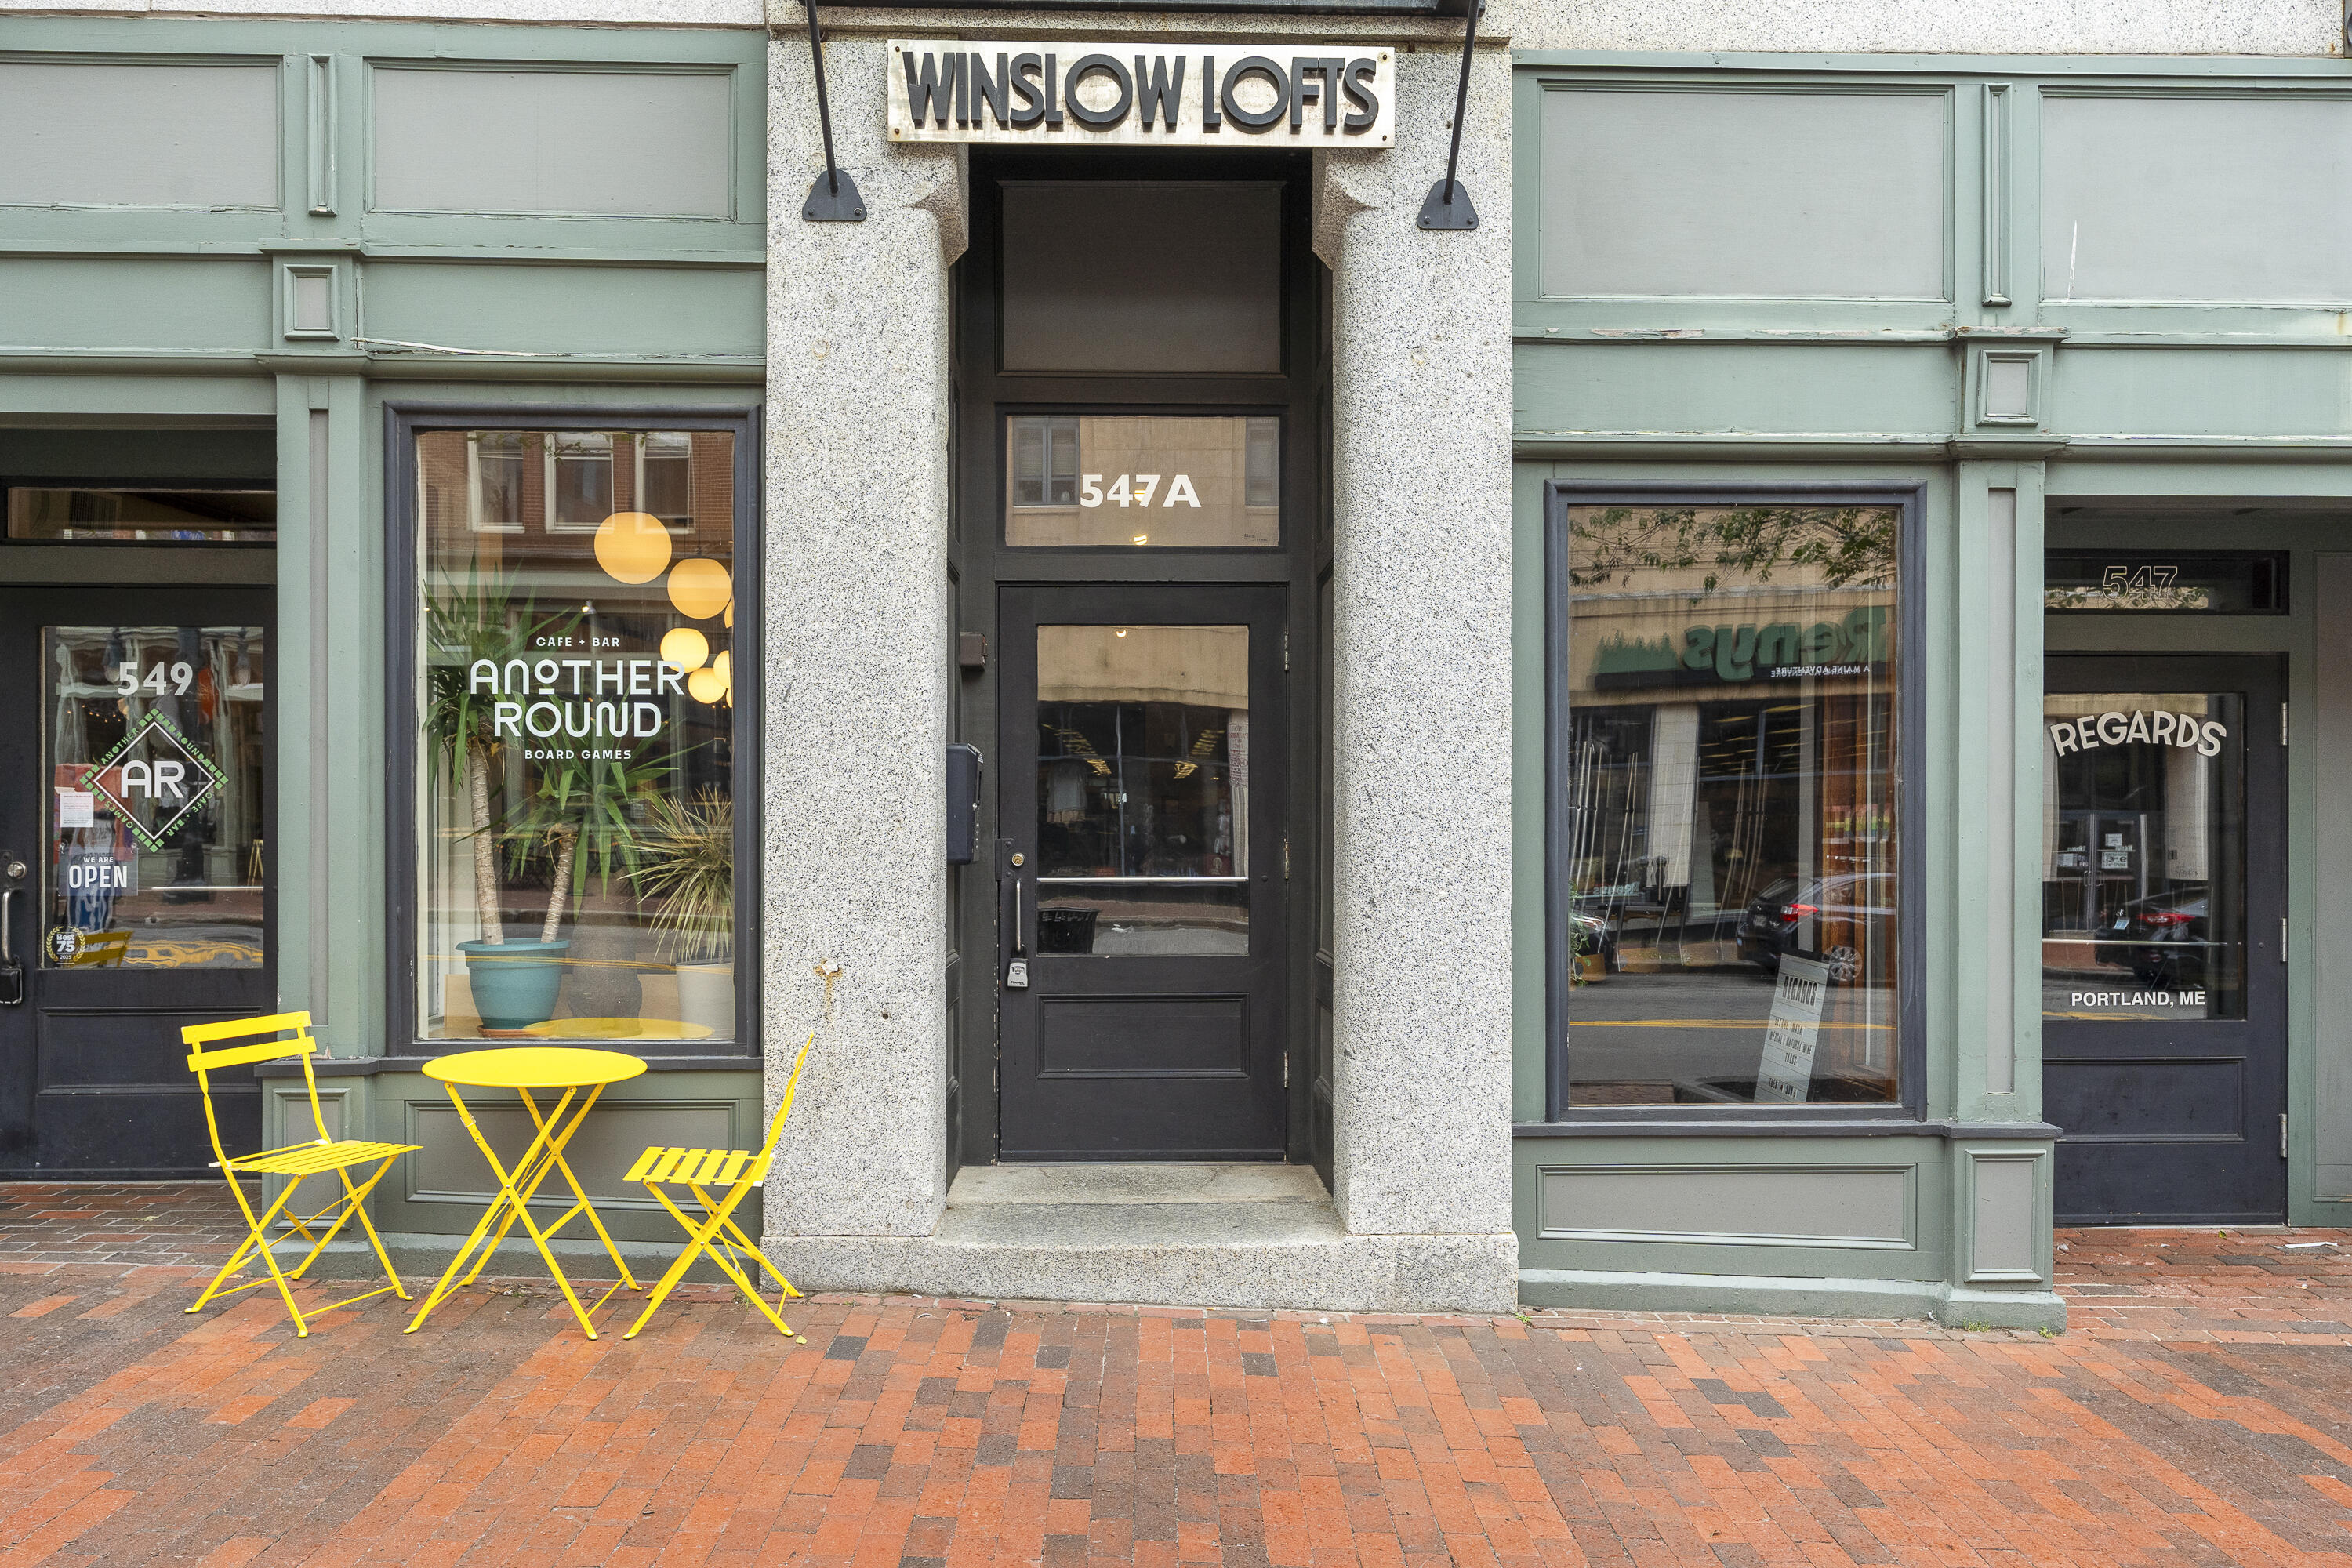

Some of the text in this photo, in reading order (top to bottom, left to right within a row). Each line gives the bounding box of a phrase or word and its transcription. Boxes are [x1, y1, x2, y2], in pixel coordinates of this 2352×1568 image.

[902, 52, 1379, 130] WINSLOW LOFTS
[1080, 474, 1202, 508] 547A
[2102, 565, 2178, 601] 547
[535, 637, 572, 647] CAFE
[592, 637, 620, 647] BAR
[118, 661, 194, 696] 549
[470, 659, 684, 695] ANOTHER
[494, 701, 662, 738] ROUND
[2049, 709, 2227, 757] REGARDS
[100, 728, 139, 765] ANOTHER
[175, 731, 205, 760] ROUND
[524, 750, 632, 760] BOARD GAMES
[121, 760, 186, 798] AR
[104, 800, 133, 829] GAMES
[191, 791, 212, 813] CAFE
[166, 818, 185, 837] BAR
[69, 865, 128, 888] OPEN
[56, 941, 75, 953] 75
[1782, 975, 1818, 1007] REGARDS
[2071, 990, 2206, 1009] PORTLAND, ME
